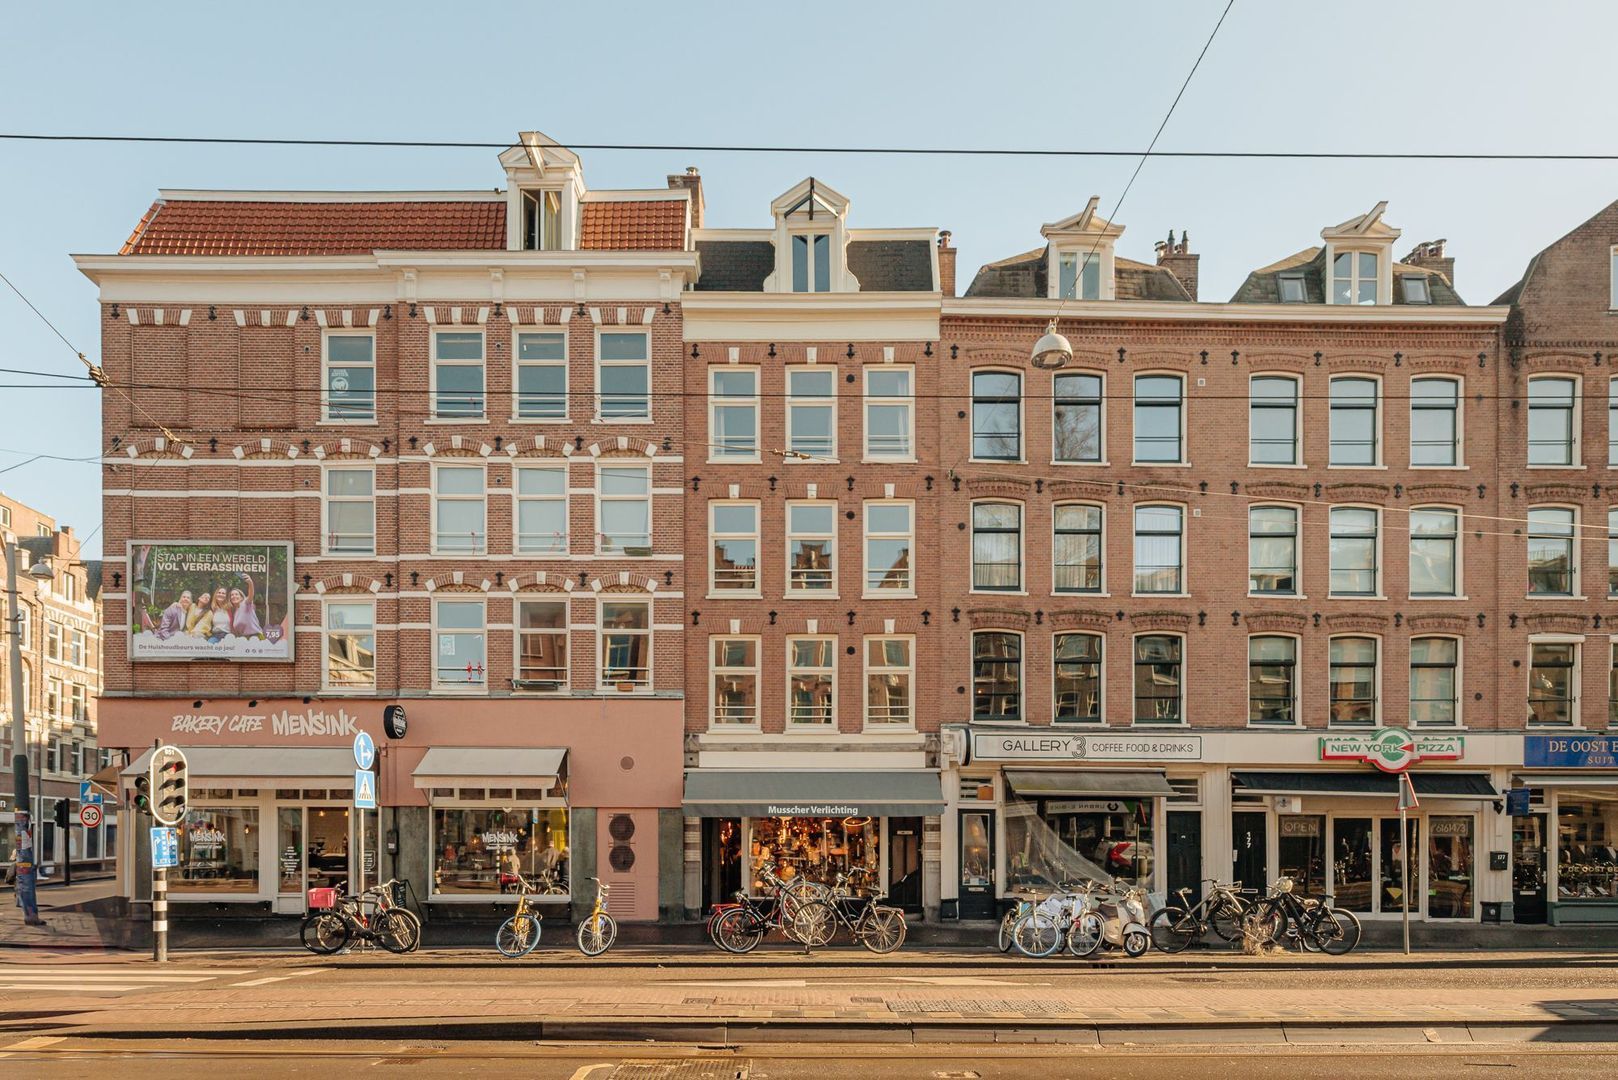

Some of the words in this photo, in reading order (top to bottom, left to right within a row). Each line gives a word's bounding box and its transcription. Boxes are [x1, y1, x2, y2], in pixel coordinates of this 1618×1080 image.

[157, 553, 182, 563] STAP
[186, 554, 197, 563] IN
[200, 554, 220, 563] EEN
[222, 554, 266, 564] WERELD
[158, 562, 180, 571] VOL
[182, 563, 267, 573] VERRASSINGEN
[265, 630, 280, 639] 7,95
[171, 714, 228, 735] BAKERY
[228, 714, 266, 732] CAFE
[271, 708, 360, 737] MENSINK
[1002, 740, 1071, 752] GALLERY
[1072, 735, 1087, 760] 3
[1126, 743, 1150, 753] FOOD
[1152, 744, 1158, 753] &
[1160, 743, 1194, 753] DRINKS
[1331, 744, 1362, 753] NEW
[1362, 744, 1403, 753] YORK
[1416, 744, 1456, 753] PIZZA
[1549, 740, 1569, 753] DE
[1570, 740, 1609, 753] OOST
[1587, 756, 1615, 764] SUIT
[84, 812, 98, 821] 30
[768, 806, 810, 814] Musscher
[810, 806, 859, 816] Verlichting
[1284, 822, 1316, 833] OPEN
[190, 830, 226, 842] MENSINK
[482, 831, 519, 843] MENSINK
